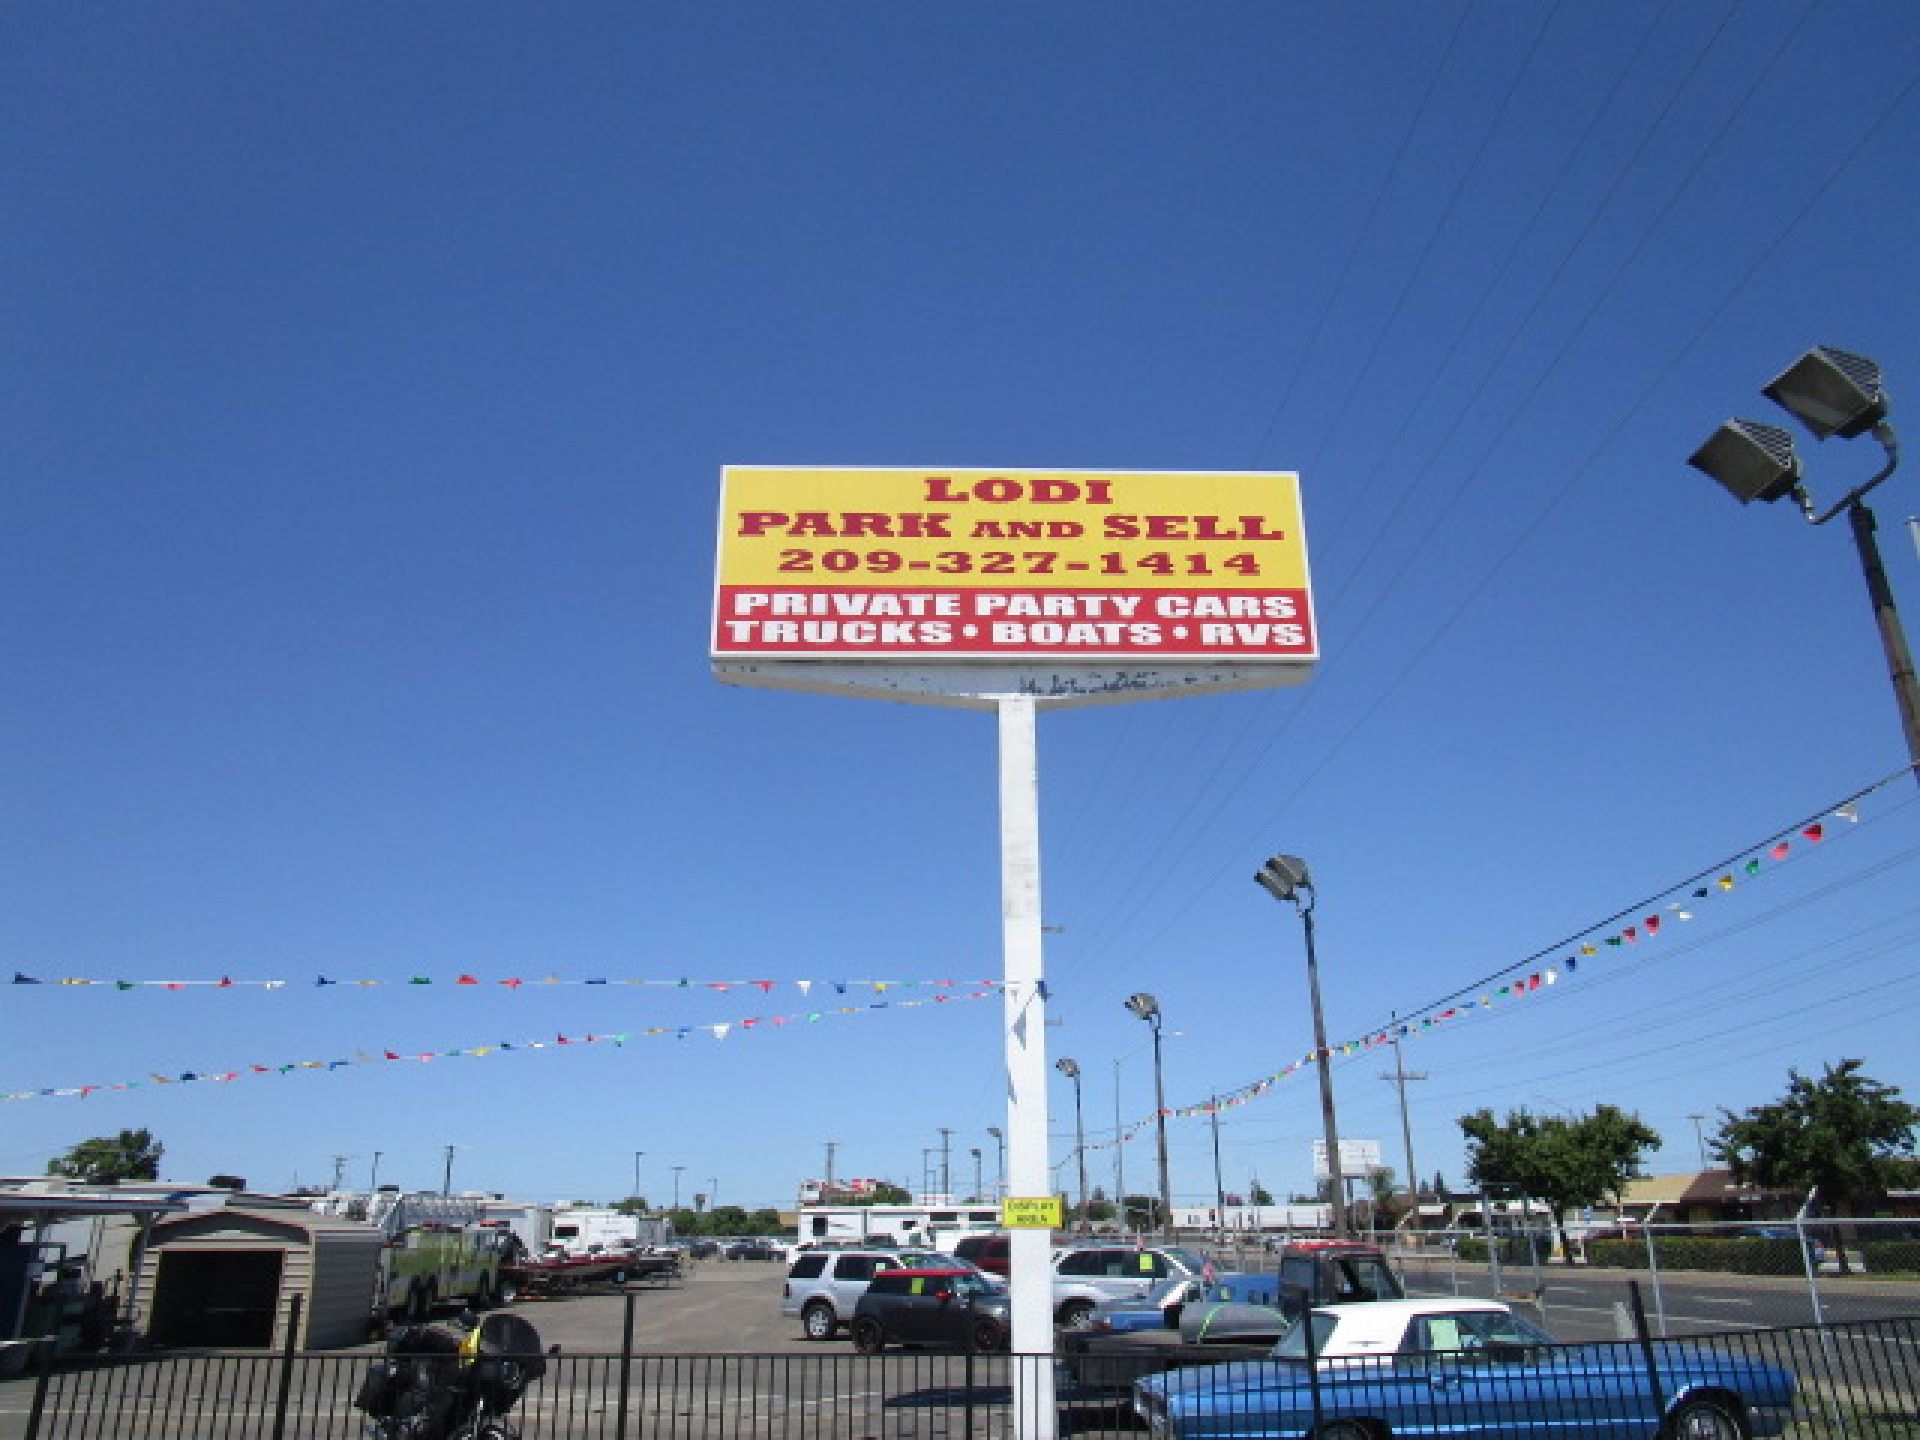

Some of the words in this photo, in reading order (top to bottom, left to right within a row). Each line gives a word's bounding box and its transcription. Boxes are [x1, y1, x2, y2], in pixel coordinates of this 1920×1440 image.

[924, 477, 1114, 504] LODI
[738, 510, 951, 538] PARK
[969, 520, 1086, 540] AND
[1103, 514, 1285, 541] SELL
[777, 549, 1261, 577] 209-327-1414
[733, 593, 962, 616] PRIVATE
[974, 593, 1144, 617] PARTY
[1156, 595, 1298, 619] CARS
[724, 620, 953, 644] TRUCKS
[991, 621, 1163, 646] BOATS
[1201, 622, 1307, 647] RVS
